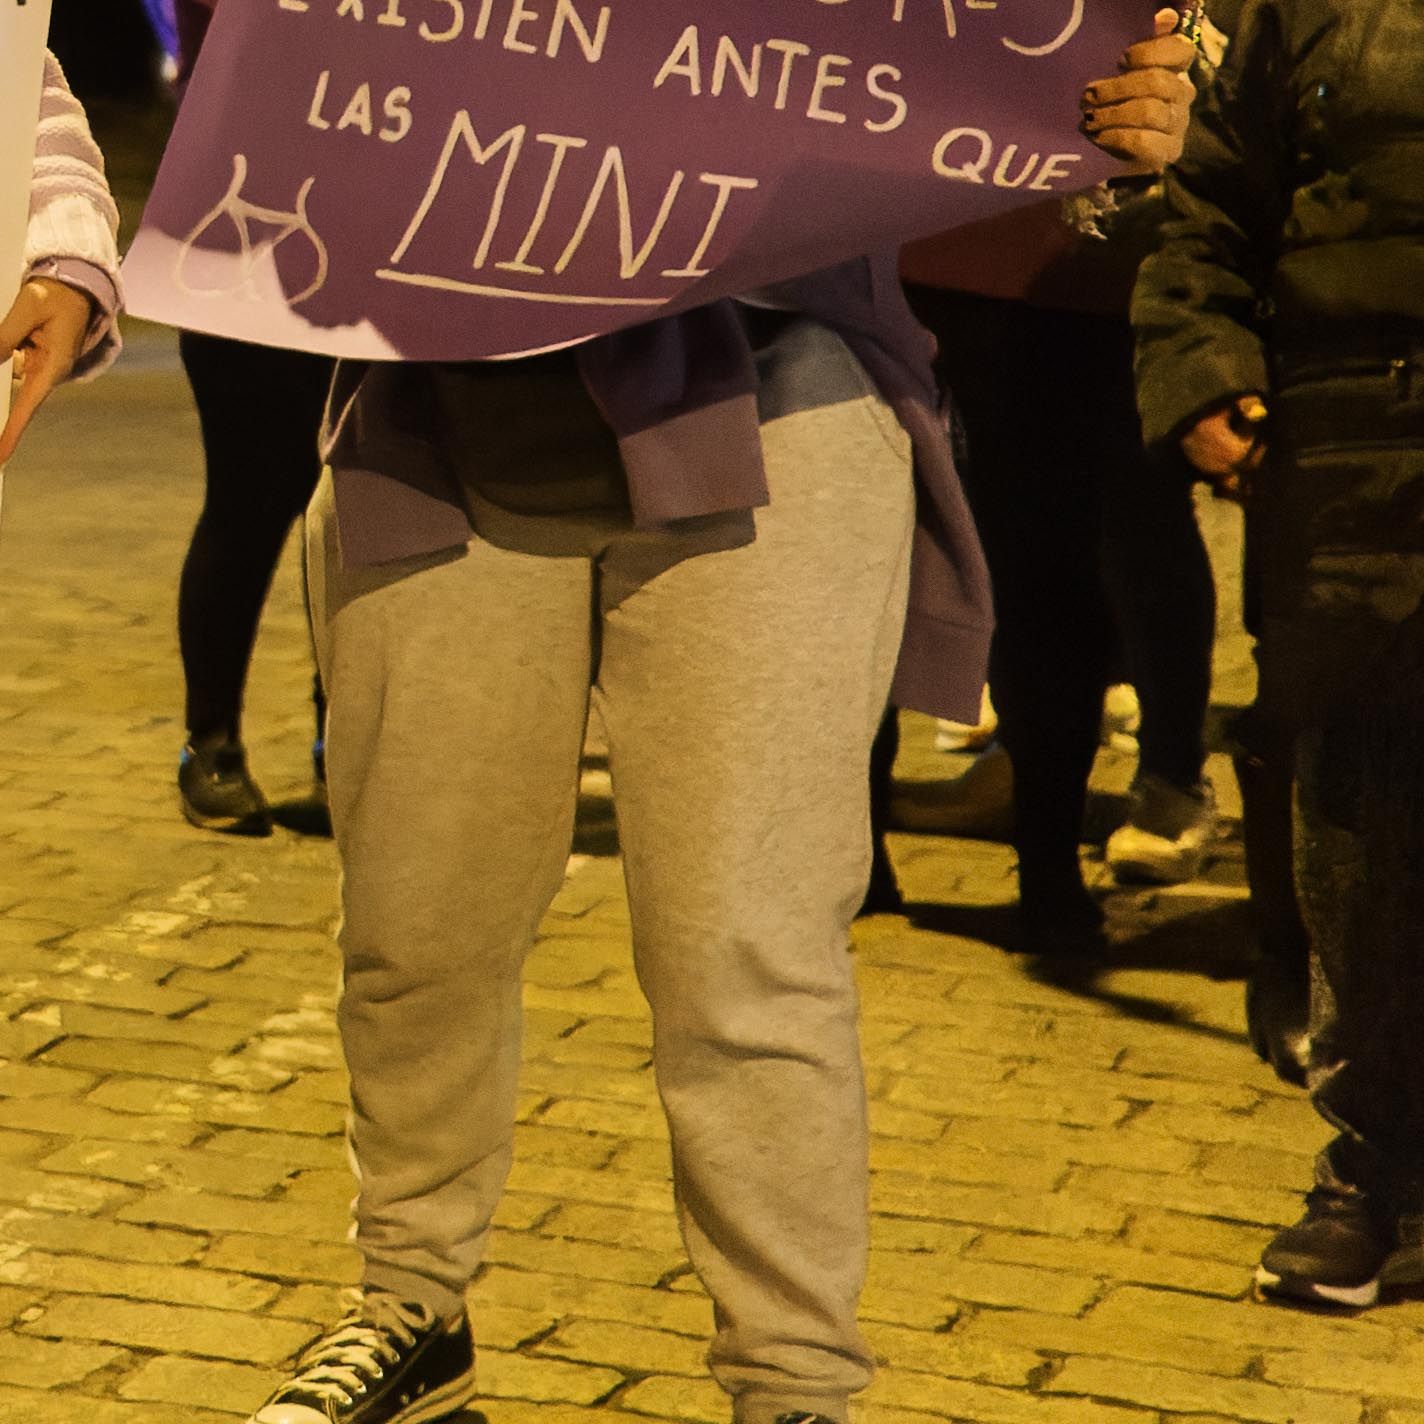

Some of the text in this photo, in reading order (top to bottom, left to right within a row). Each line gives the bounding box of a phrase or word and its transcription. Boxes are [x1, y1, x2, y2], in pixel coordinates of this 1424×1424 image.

[304, 68, 760, 280] LAS MINI
[652, 22, 910, 136] ANTES
[930, 124, 1084, 194] QUE
